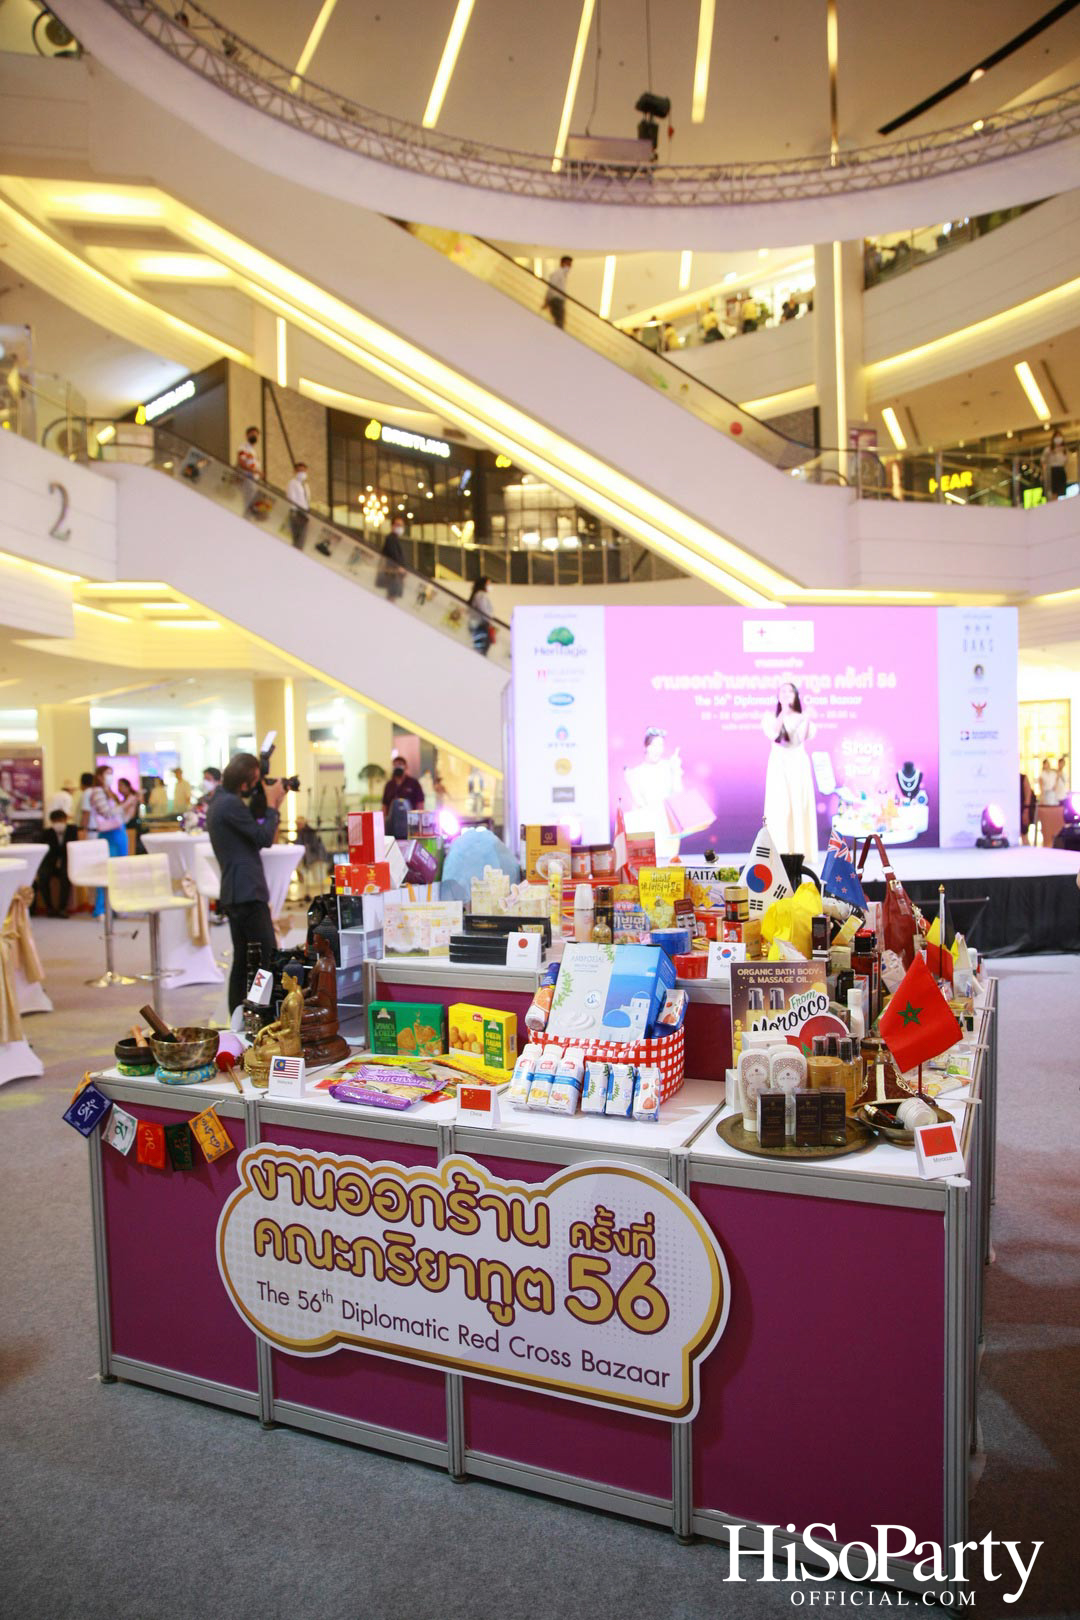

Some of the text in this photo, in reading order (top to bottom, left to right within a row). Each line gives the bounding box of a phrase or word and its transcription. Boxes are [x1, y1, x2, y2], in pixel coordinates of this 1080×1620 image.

[48, 481, 71, 541] 2
[737, 968, 819, 976] ORGANIC BATH BODY
[757, 976, 794, 984] MASSAGE
[790, 990, 817, 1010] From
[250, 1159, 550, 1249] งานออกร้าน
[569, 1204, 655, 1260] ครั้งที่
[564, 1253, 670, 1335] 56
[257, 1280, 671, 1388] The 56th Diplomatic Red Cross Bazaar
